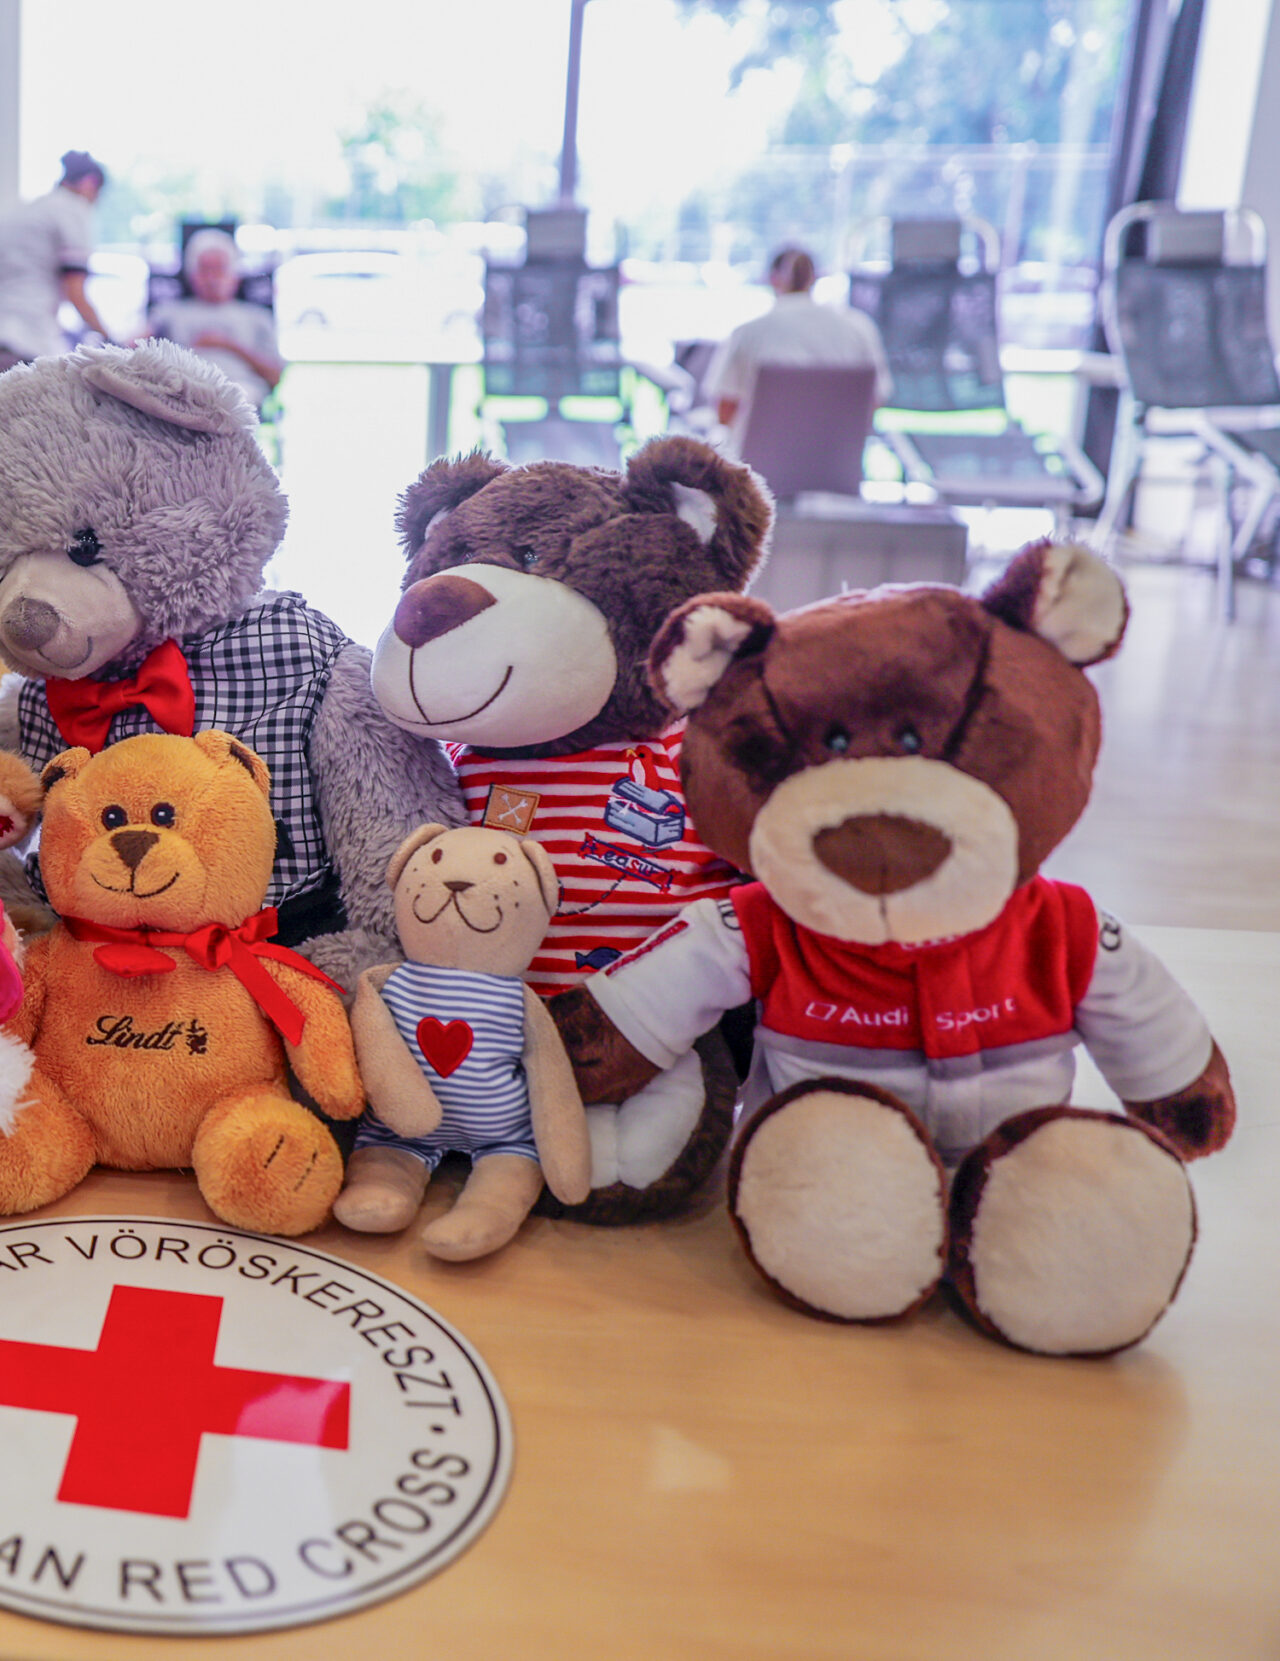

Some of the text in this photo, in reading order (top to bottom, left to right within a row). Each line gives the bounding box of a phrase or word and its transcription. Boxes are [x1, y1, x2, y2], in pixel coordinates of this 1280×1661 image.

[86, 1015, 182, 1050] Lindt
[840, 998, 1015, 1031] Audi Sport
[65, 1229, 462, 1417] VÖRÖSKERESZT
[119, 1555, 276, 1601] RED
[298, 1448, 470, 1580] CROSS
